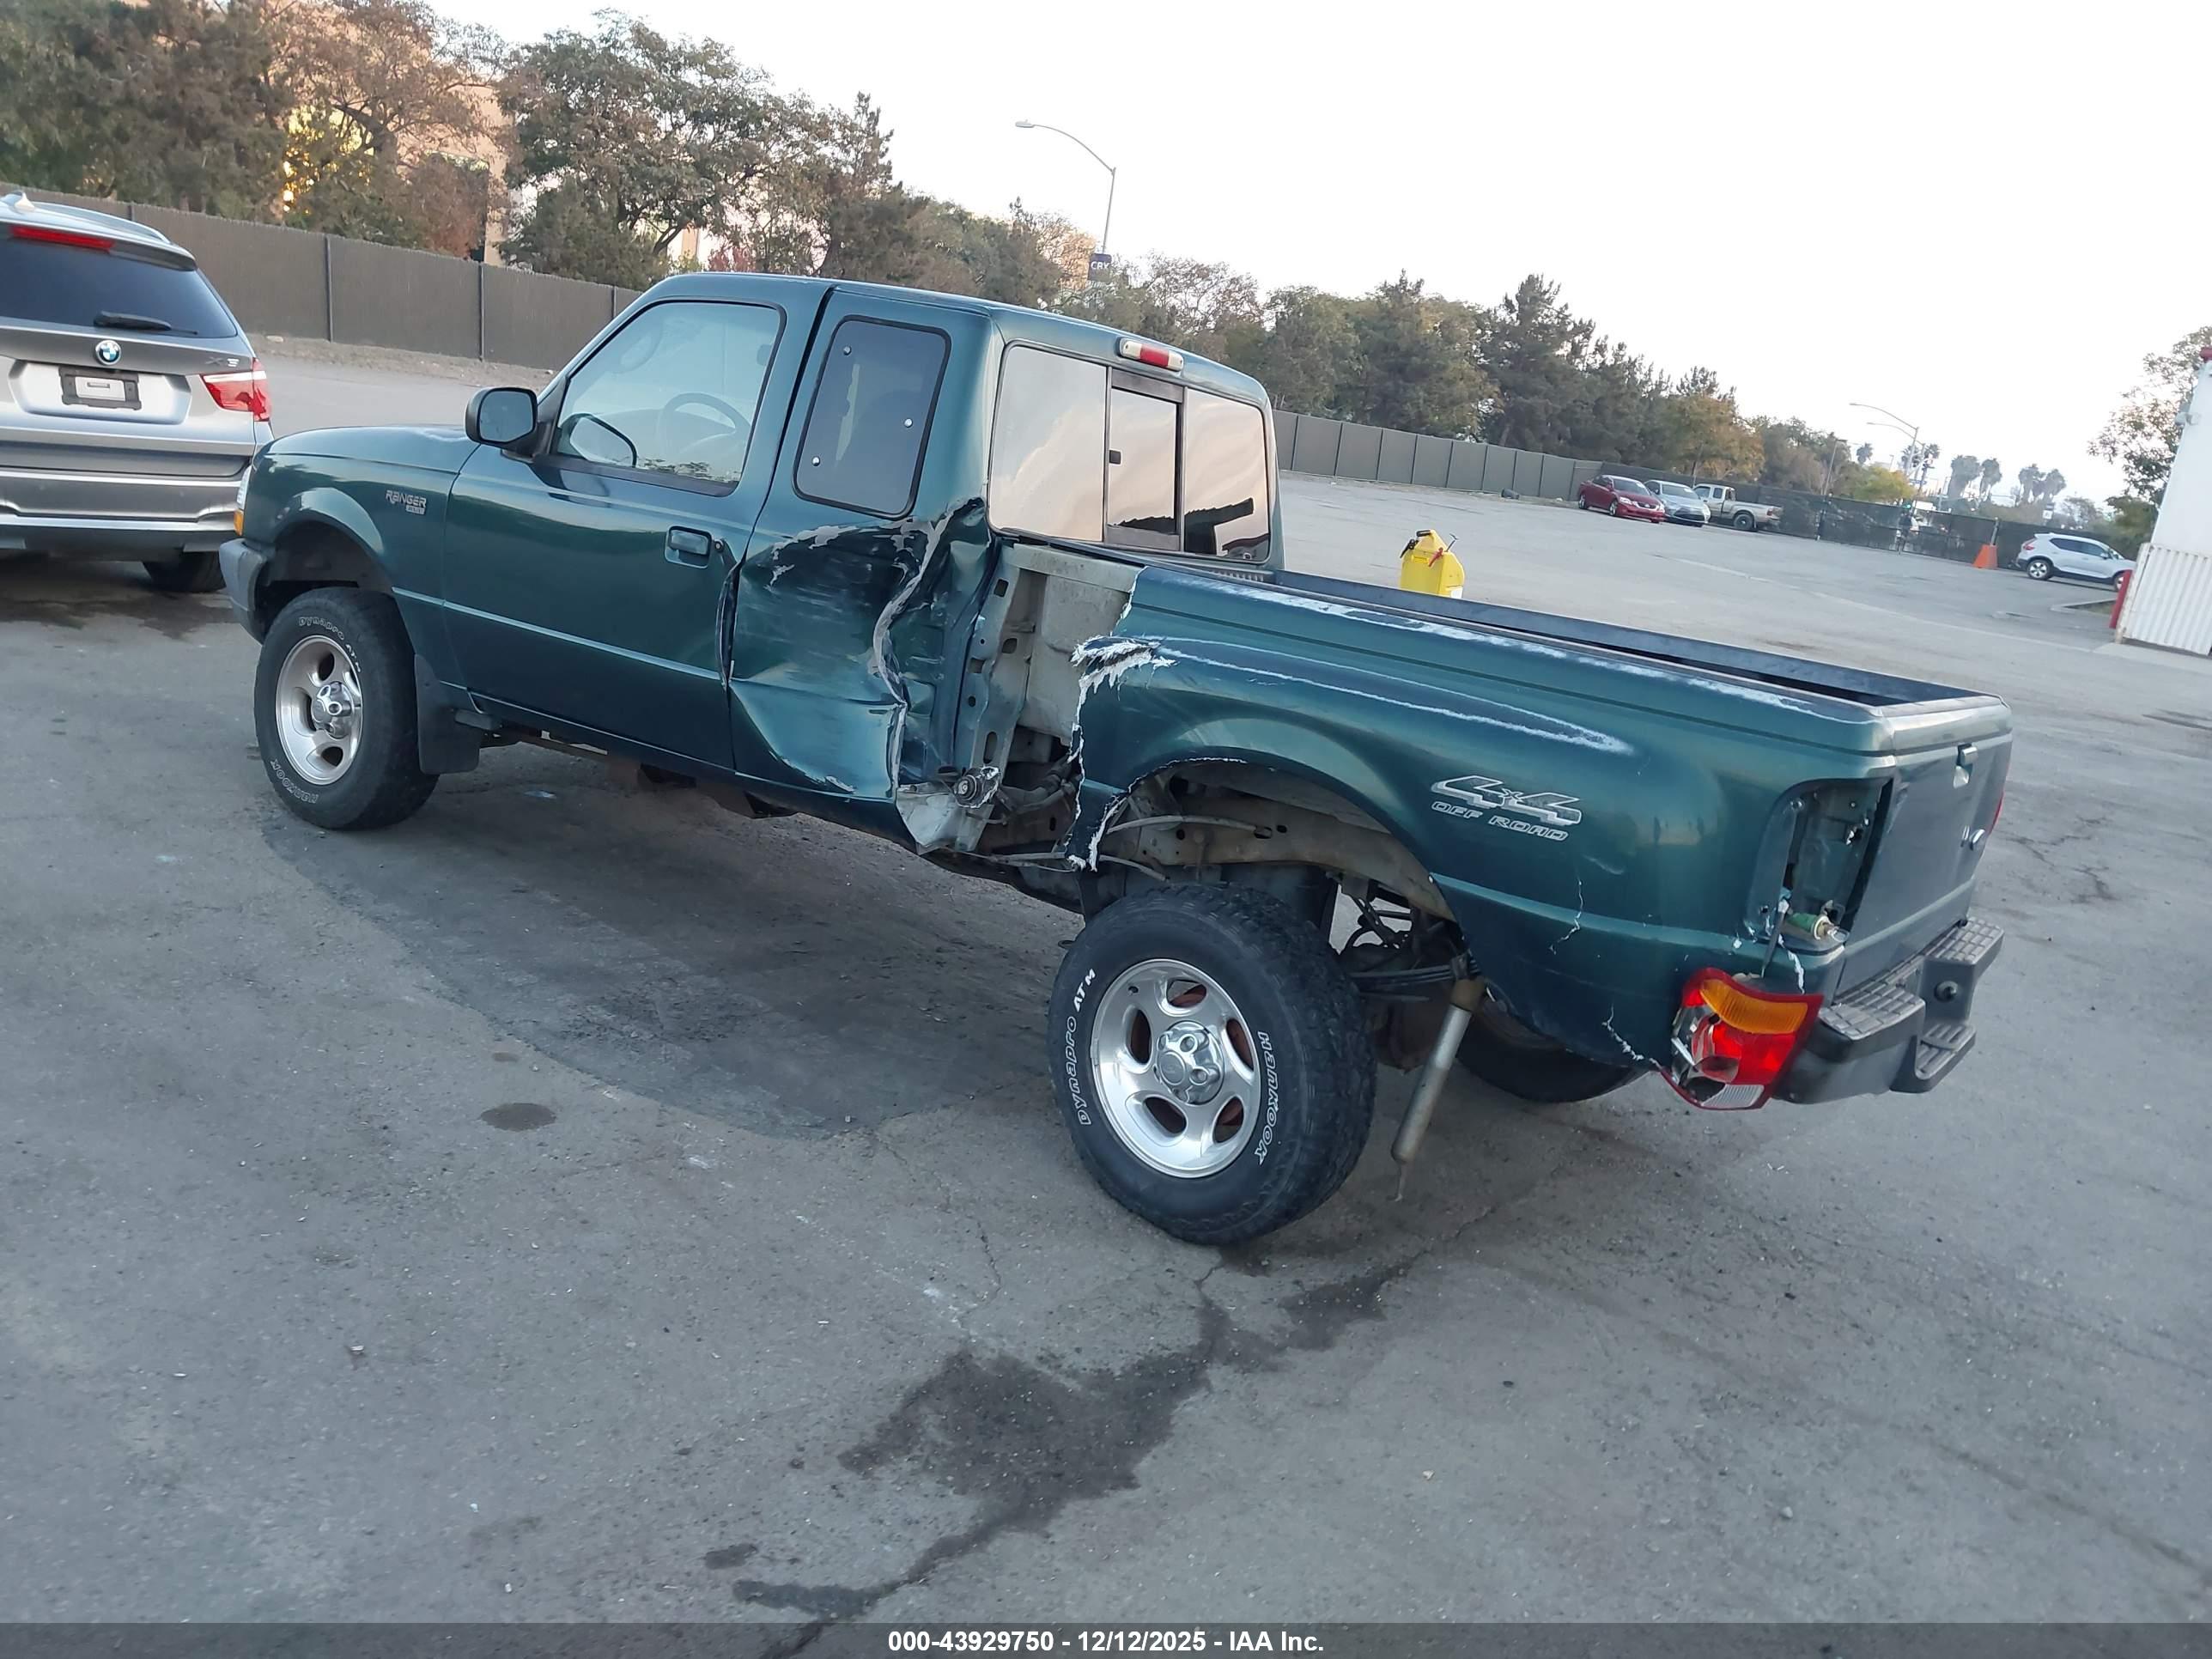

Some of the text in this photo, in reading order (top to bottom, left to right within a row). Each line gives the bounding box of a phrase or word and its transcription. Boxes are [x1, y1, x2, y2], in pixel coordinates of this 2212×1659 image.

[385, 489, 427, 508] RANGER
[1431, 800, 1570, 842] OFF ROAD
